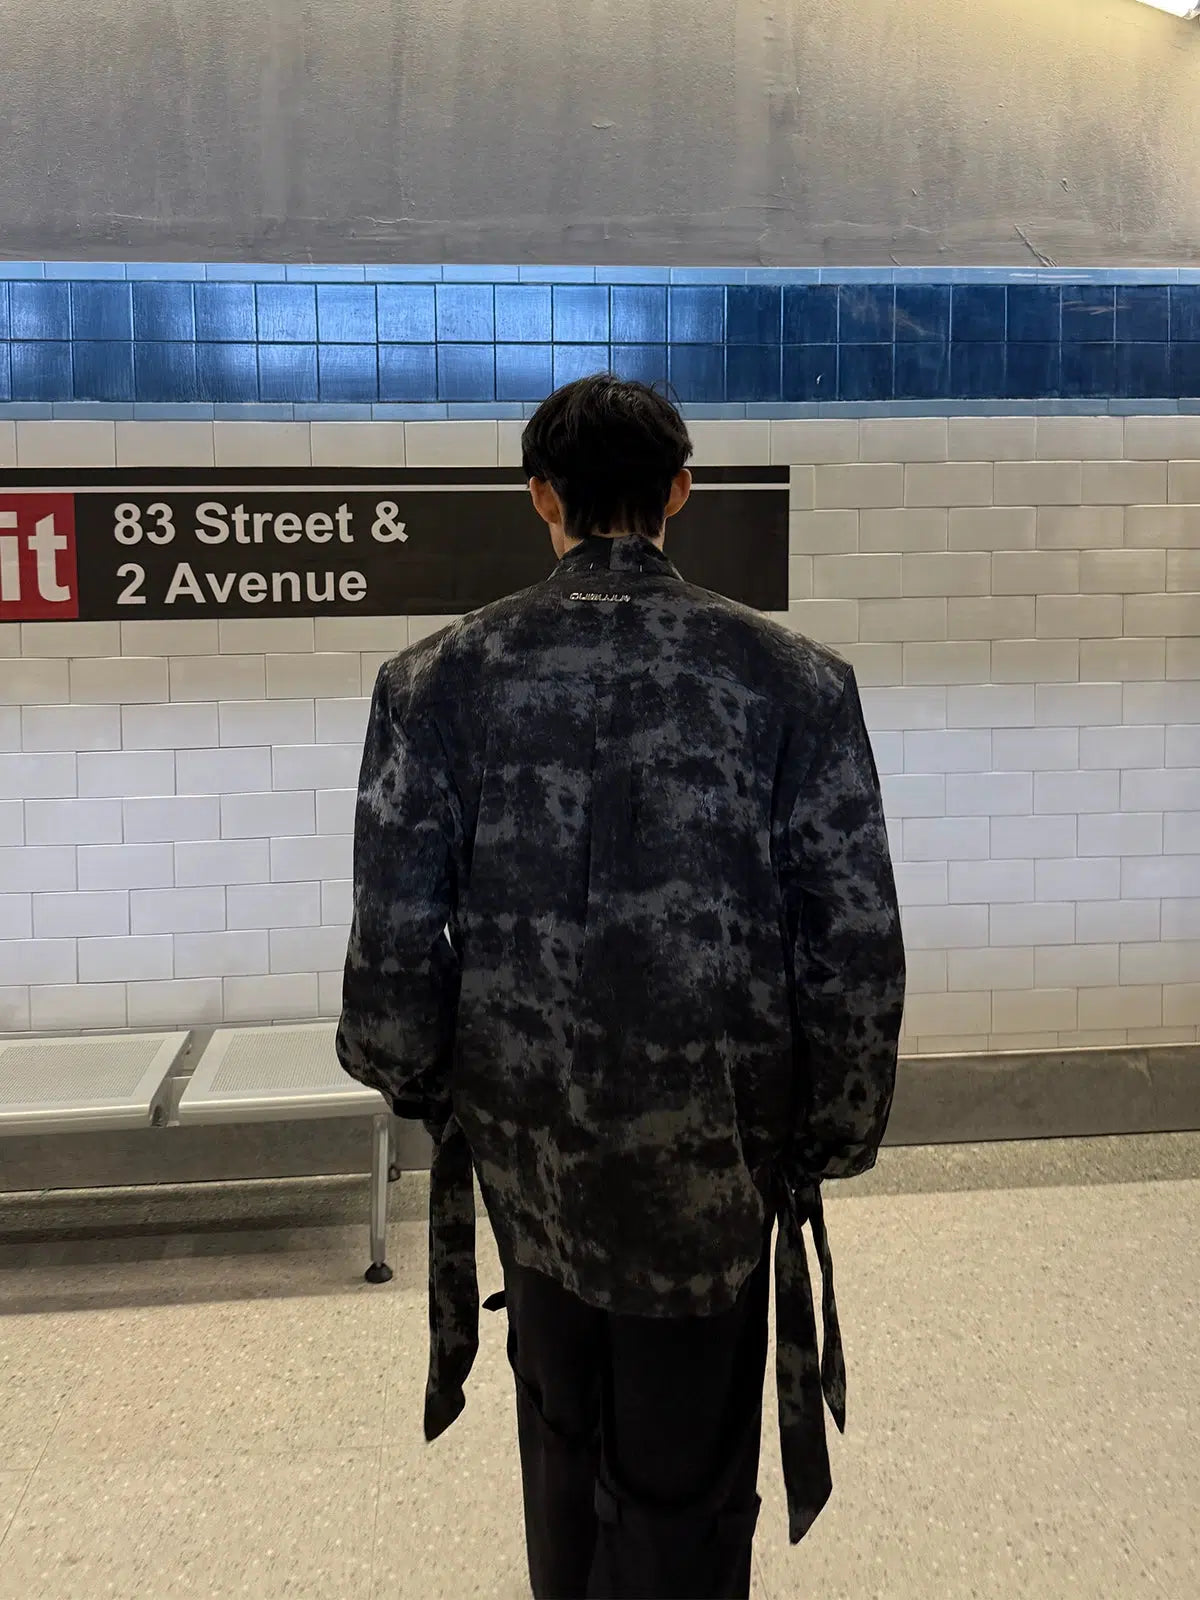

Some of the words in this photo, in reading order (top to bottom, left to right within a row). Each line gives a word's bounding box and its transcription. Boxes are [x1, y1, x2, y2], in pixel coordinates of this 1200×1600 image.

[115, 502, 176, 545] 83
[194, 502, 354, 544] Street
[372, 501, 409, 543] &
[116, 563, 146, 605] 2
[165, 563, 367, 604] Avenue
